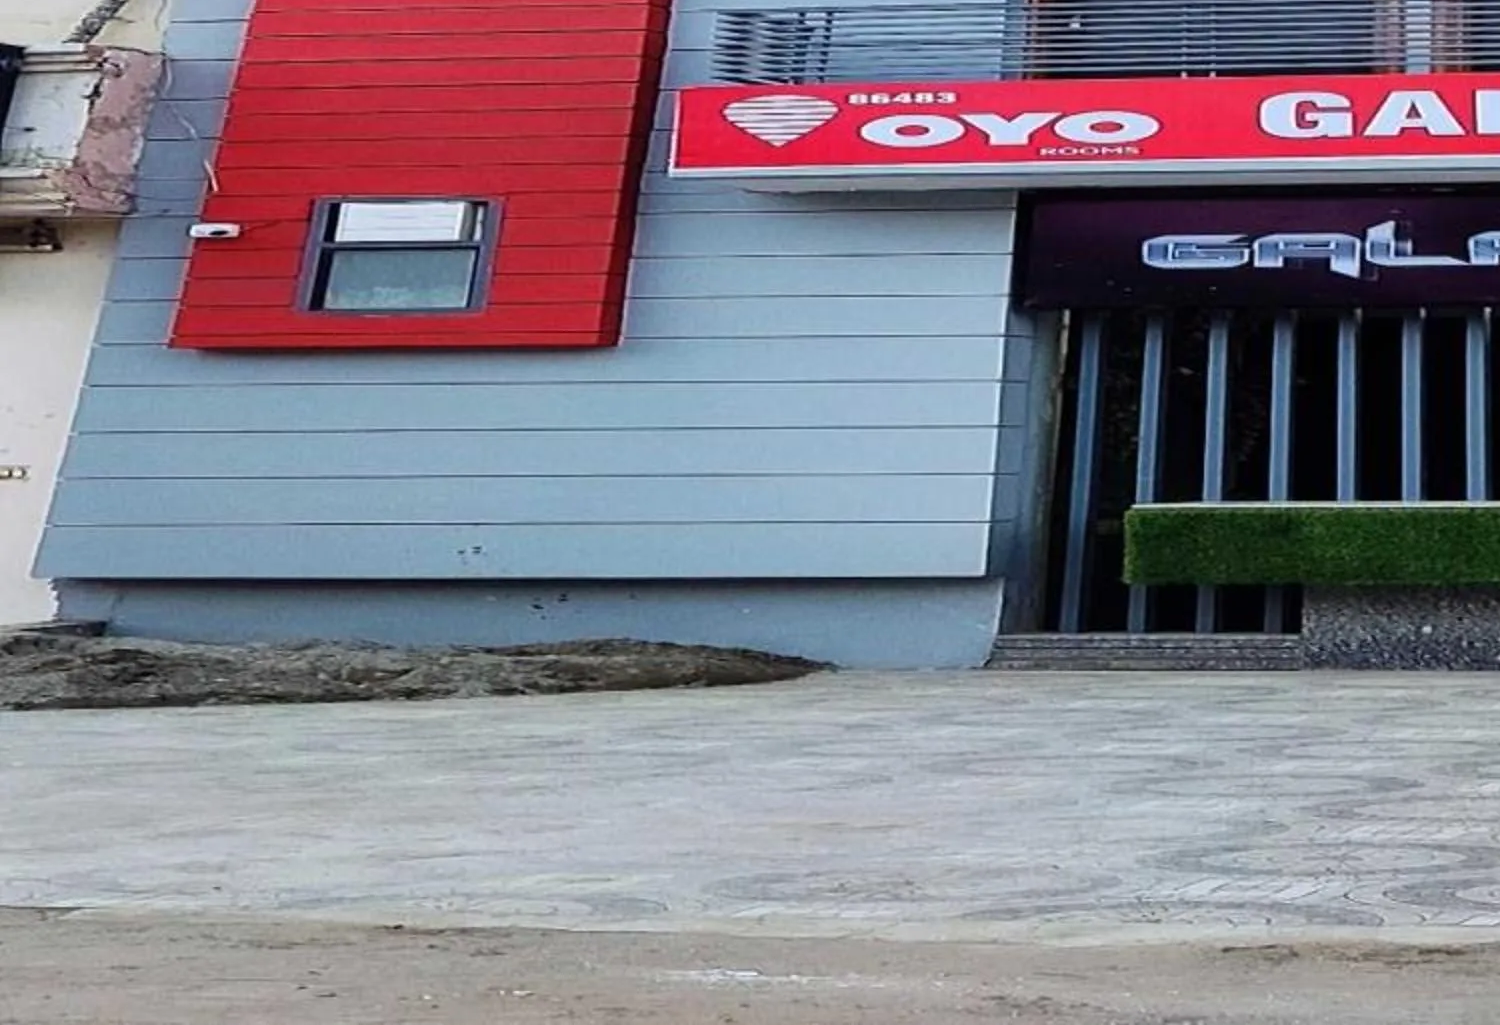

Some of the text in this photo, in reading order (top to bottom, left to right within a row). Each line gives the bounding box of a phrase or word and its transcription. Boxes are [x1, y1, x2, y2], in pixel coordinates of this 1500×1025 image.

[848, 91, 957, 105] 86483
[859, 110, 1160, 148] OYO
[1039, 146, 1141, 156] ROOMS
